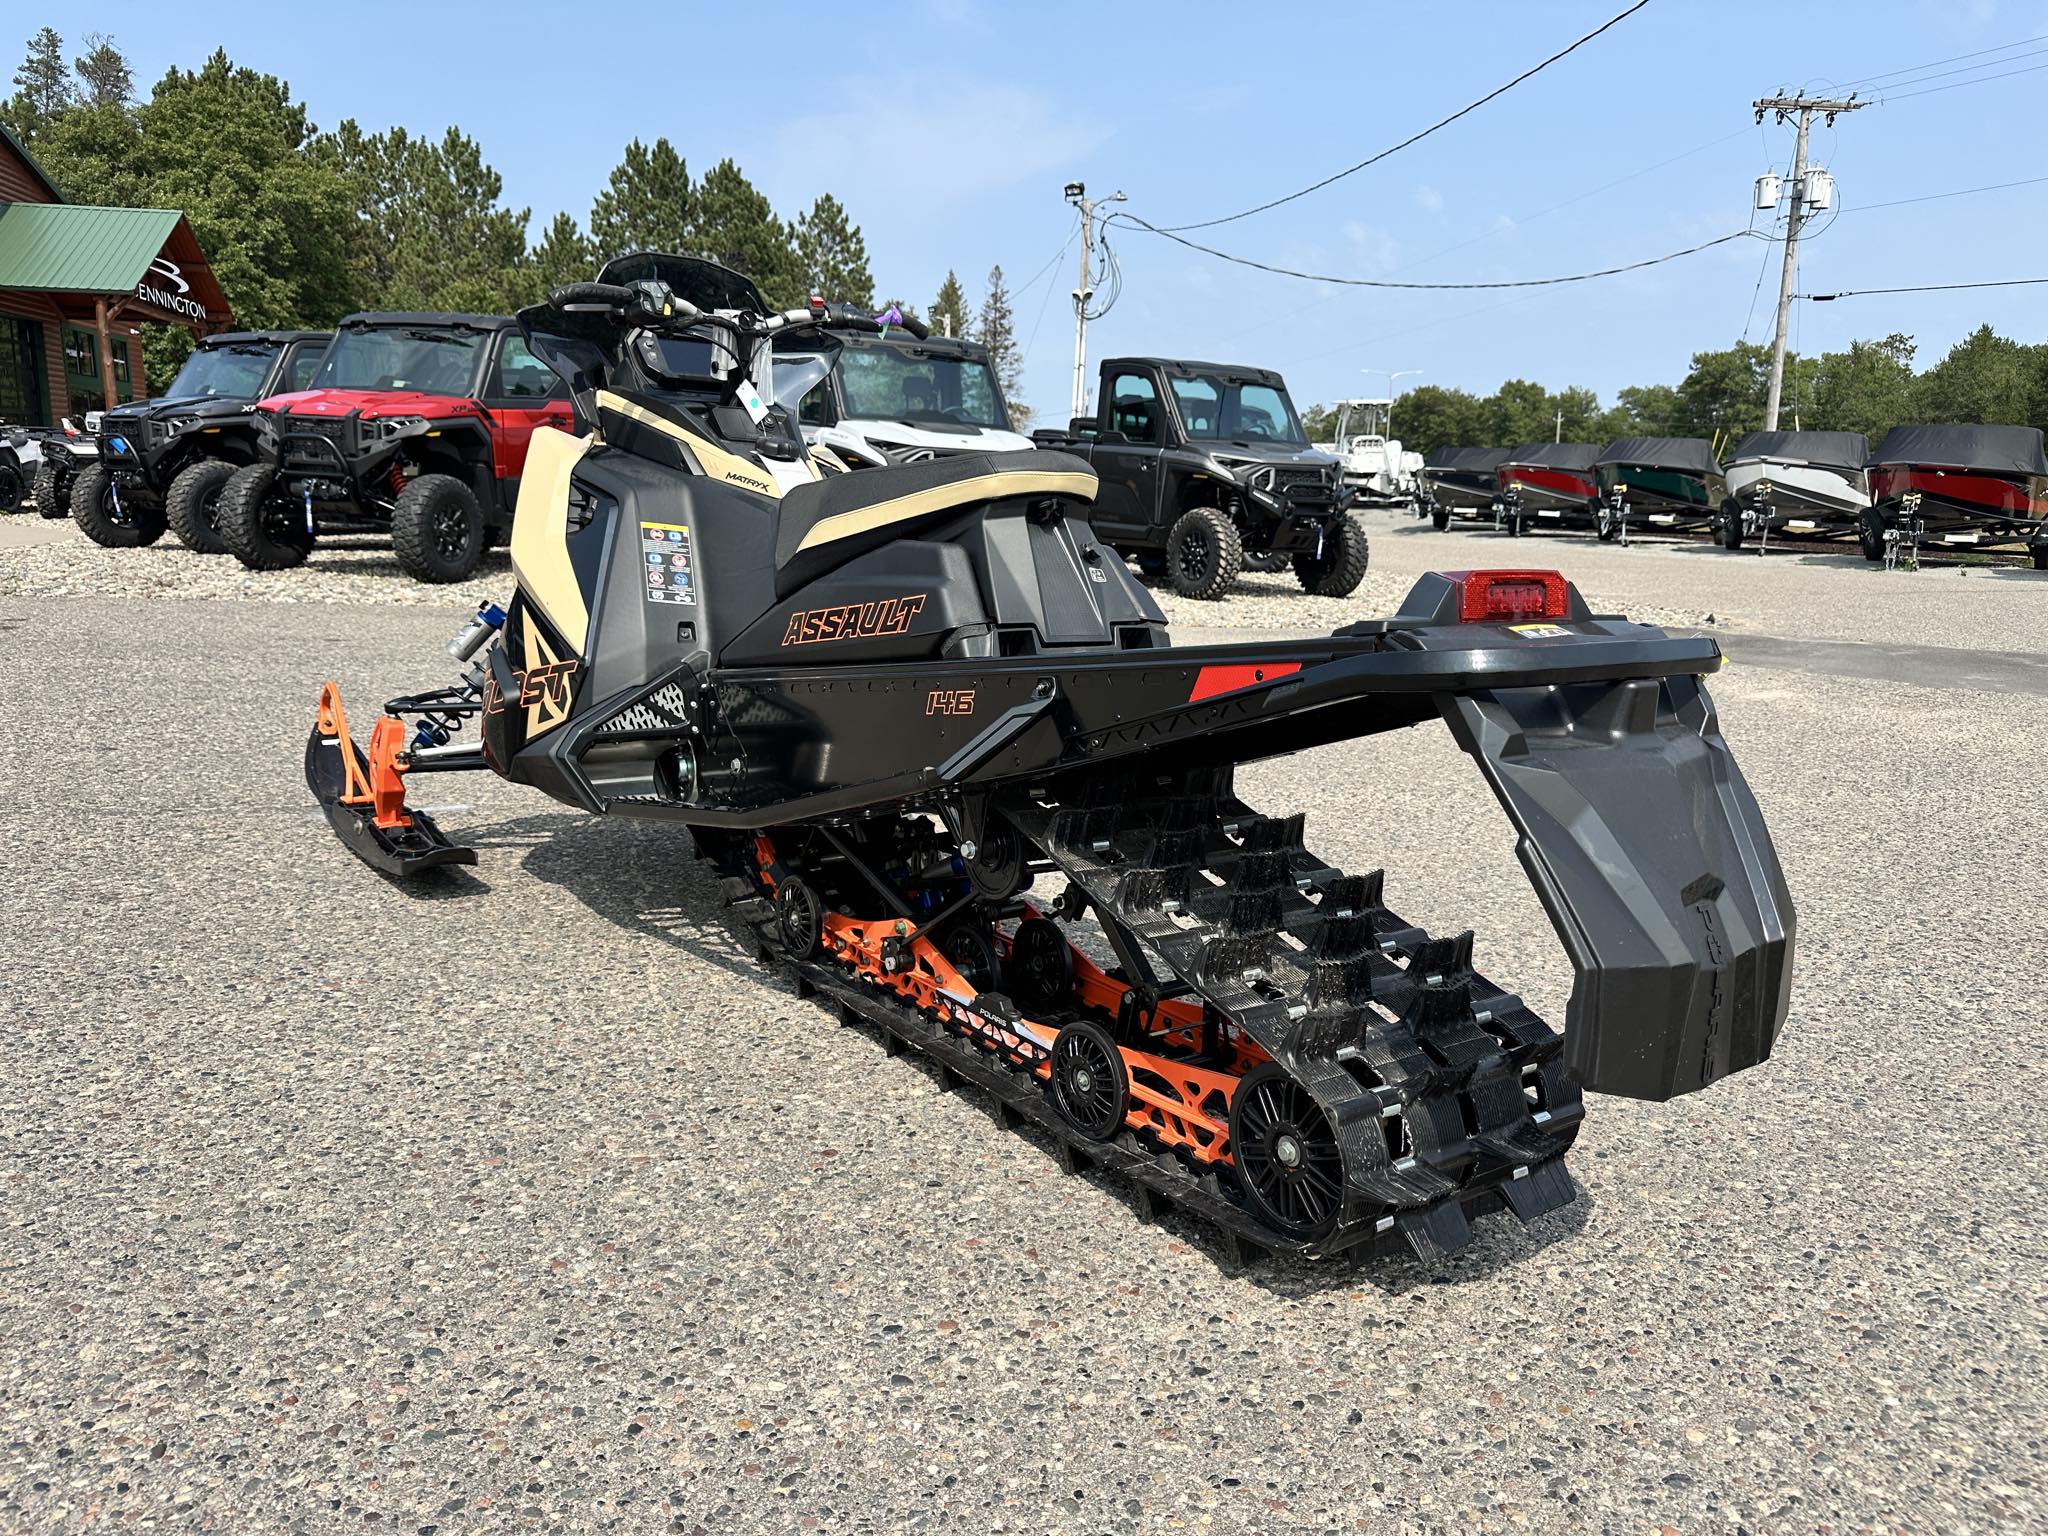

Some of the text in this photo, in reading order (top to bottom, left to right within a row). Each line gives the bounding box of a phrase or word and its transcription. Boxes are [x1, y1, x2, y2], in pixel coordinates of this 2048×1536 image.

[136, 282, 206, 319] ENNINGTON
[725, 471, 770, 493] MATRYX
[781, 594, 927, 646] ASSAULT
[926, 690, 975, 715] 146
[979, 1007, 1007, 1027] POLARIS
